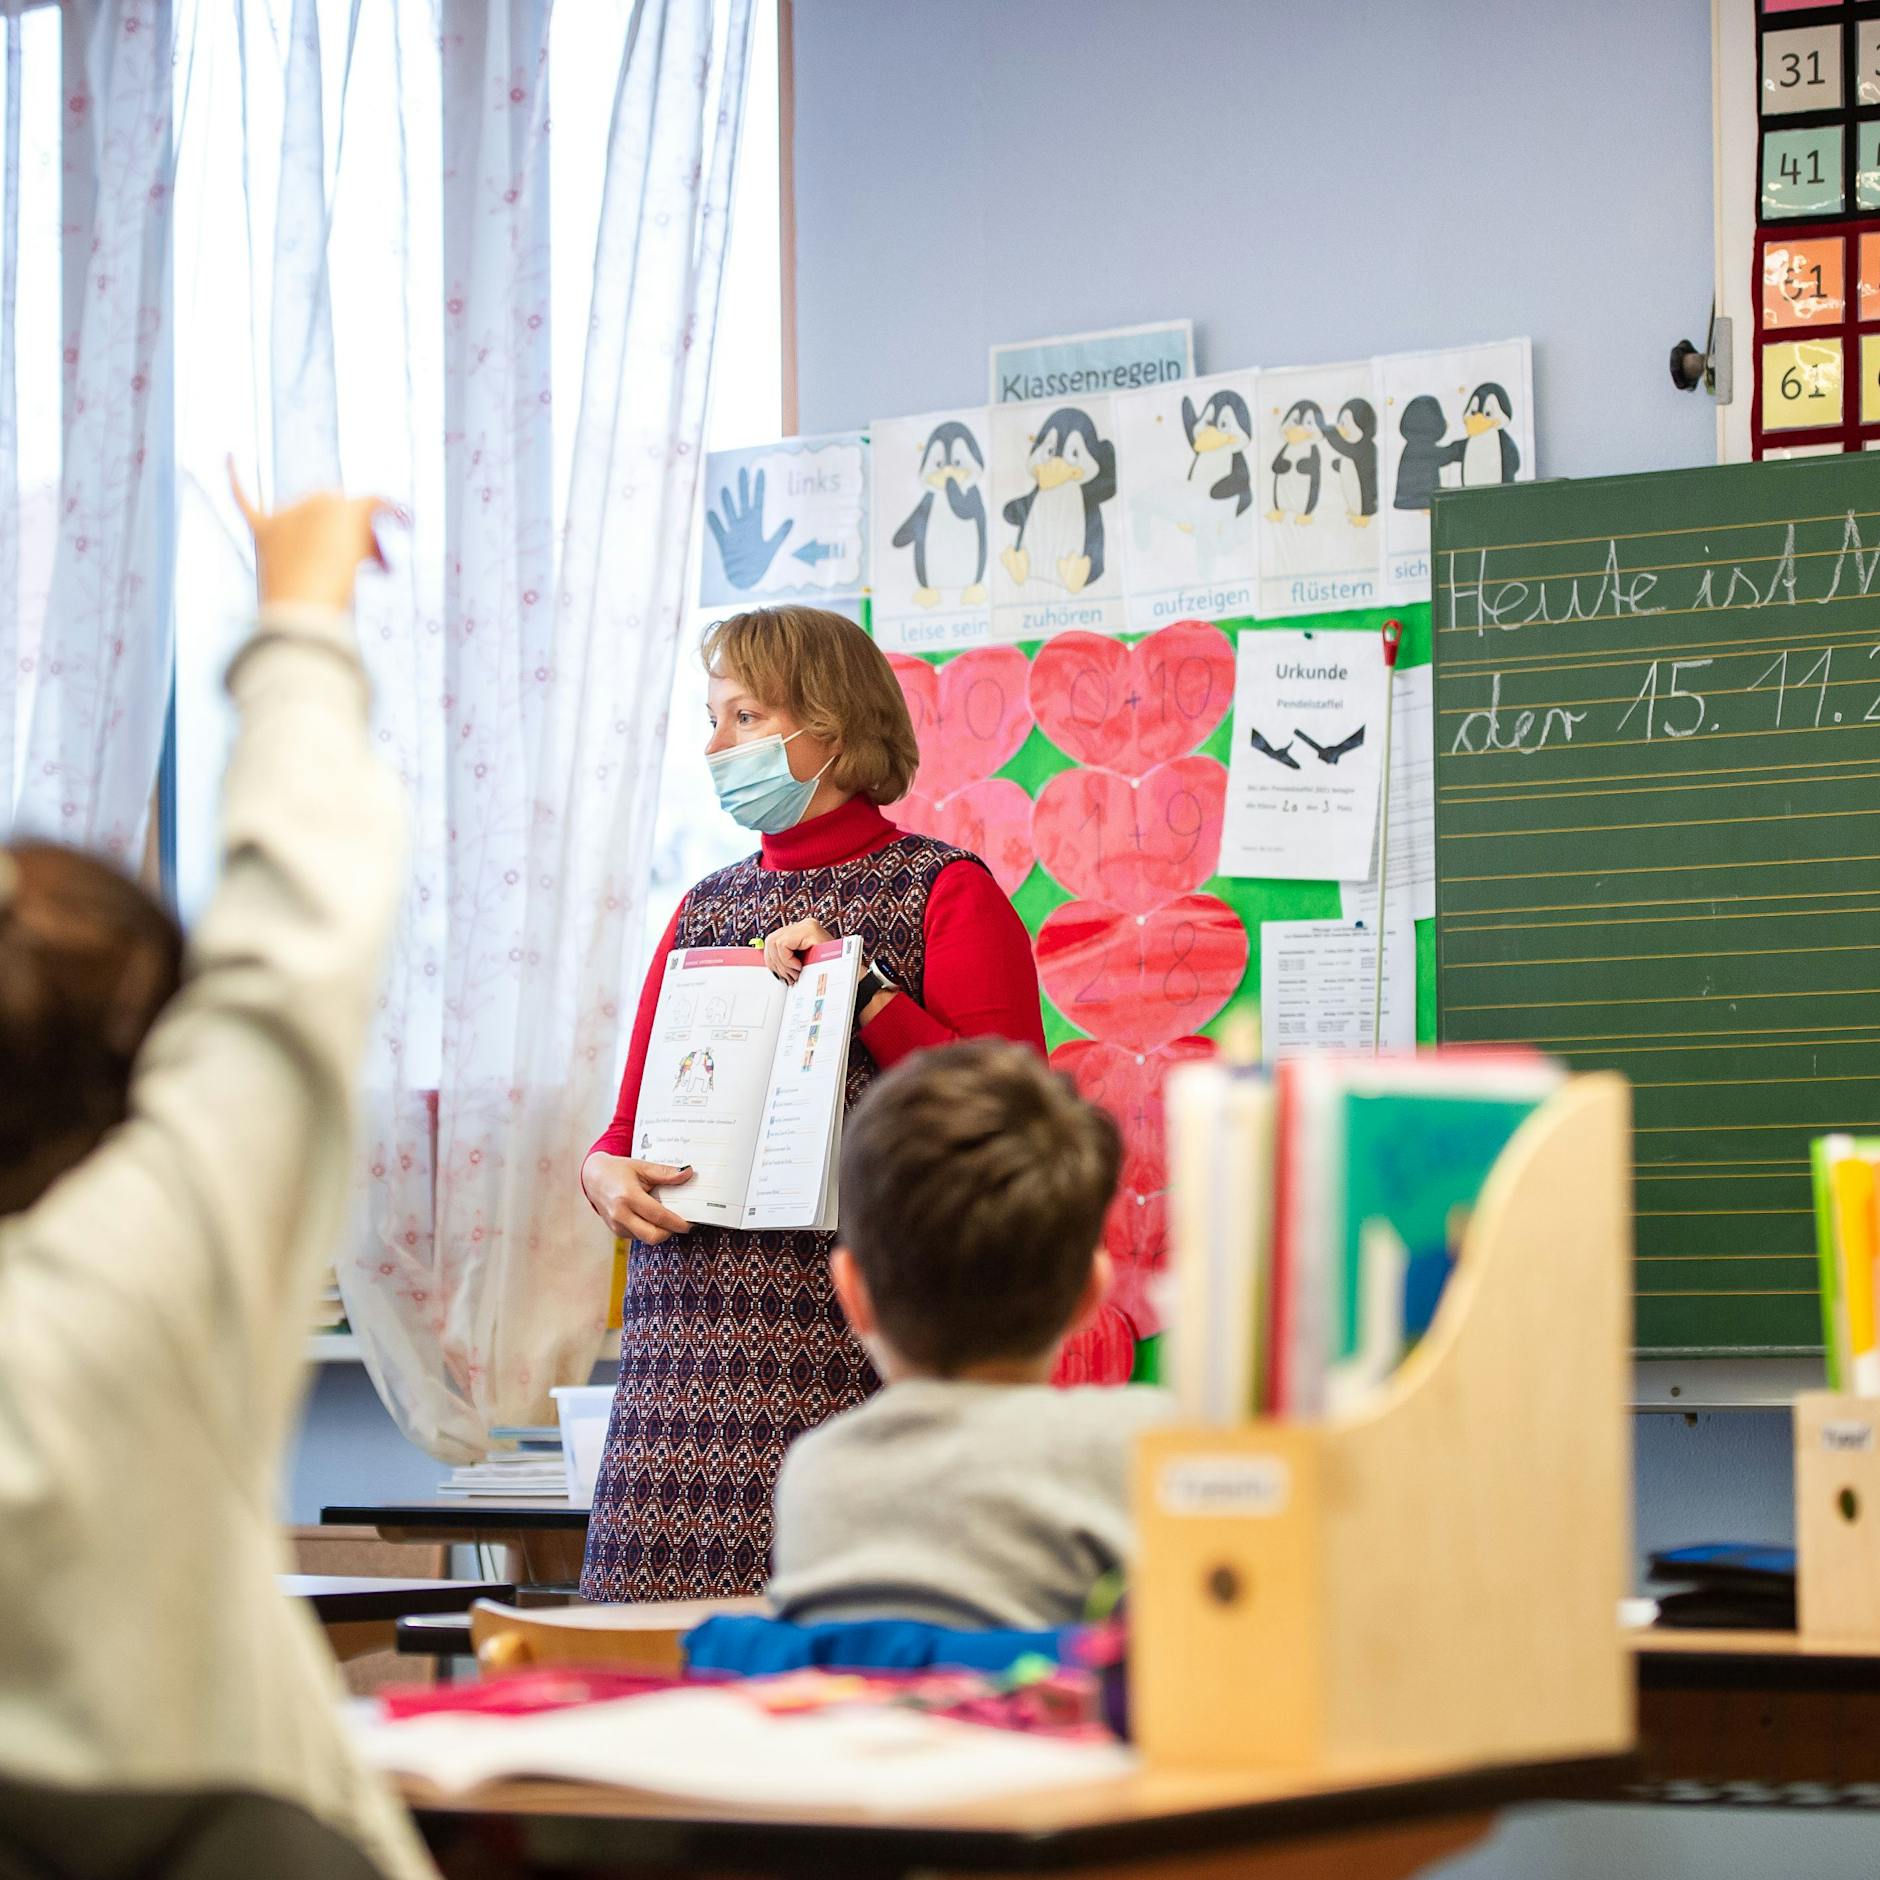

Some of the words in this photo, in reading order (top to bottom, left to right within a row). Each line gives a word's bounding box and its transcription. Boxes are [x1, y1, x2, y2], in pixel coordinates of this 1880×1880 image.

[1779, 50, 1825, 88] 31
[1779, 149, 1825, 186] 41
[1002, 359, 1182, 402] Klassenregeln
[1781, 363, 1826, 400] 61
[788, 467, 842, 496] links
[1394, 559, 1428, 579] sich
[1450, 538, 1667, 637] Heute
[1692, 523, 1796, 609] ist
[1153, 587, 1251, 617] aufzeigen
[1291, 580, 1374, 604] flüstern
[901, 622, 945, 643] leise
[1022, 606, 1103, 630] zuhören
[1276, 663, 1348, 680] Urkunde
[1451, 672, 1587, 755] der
